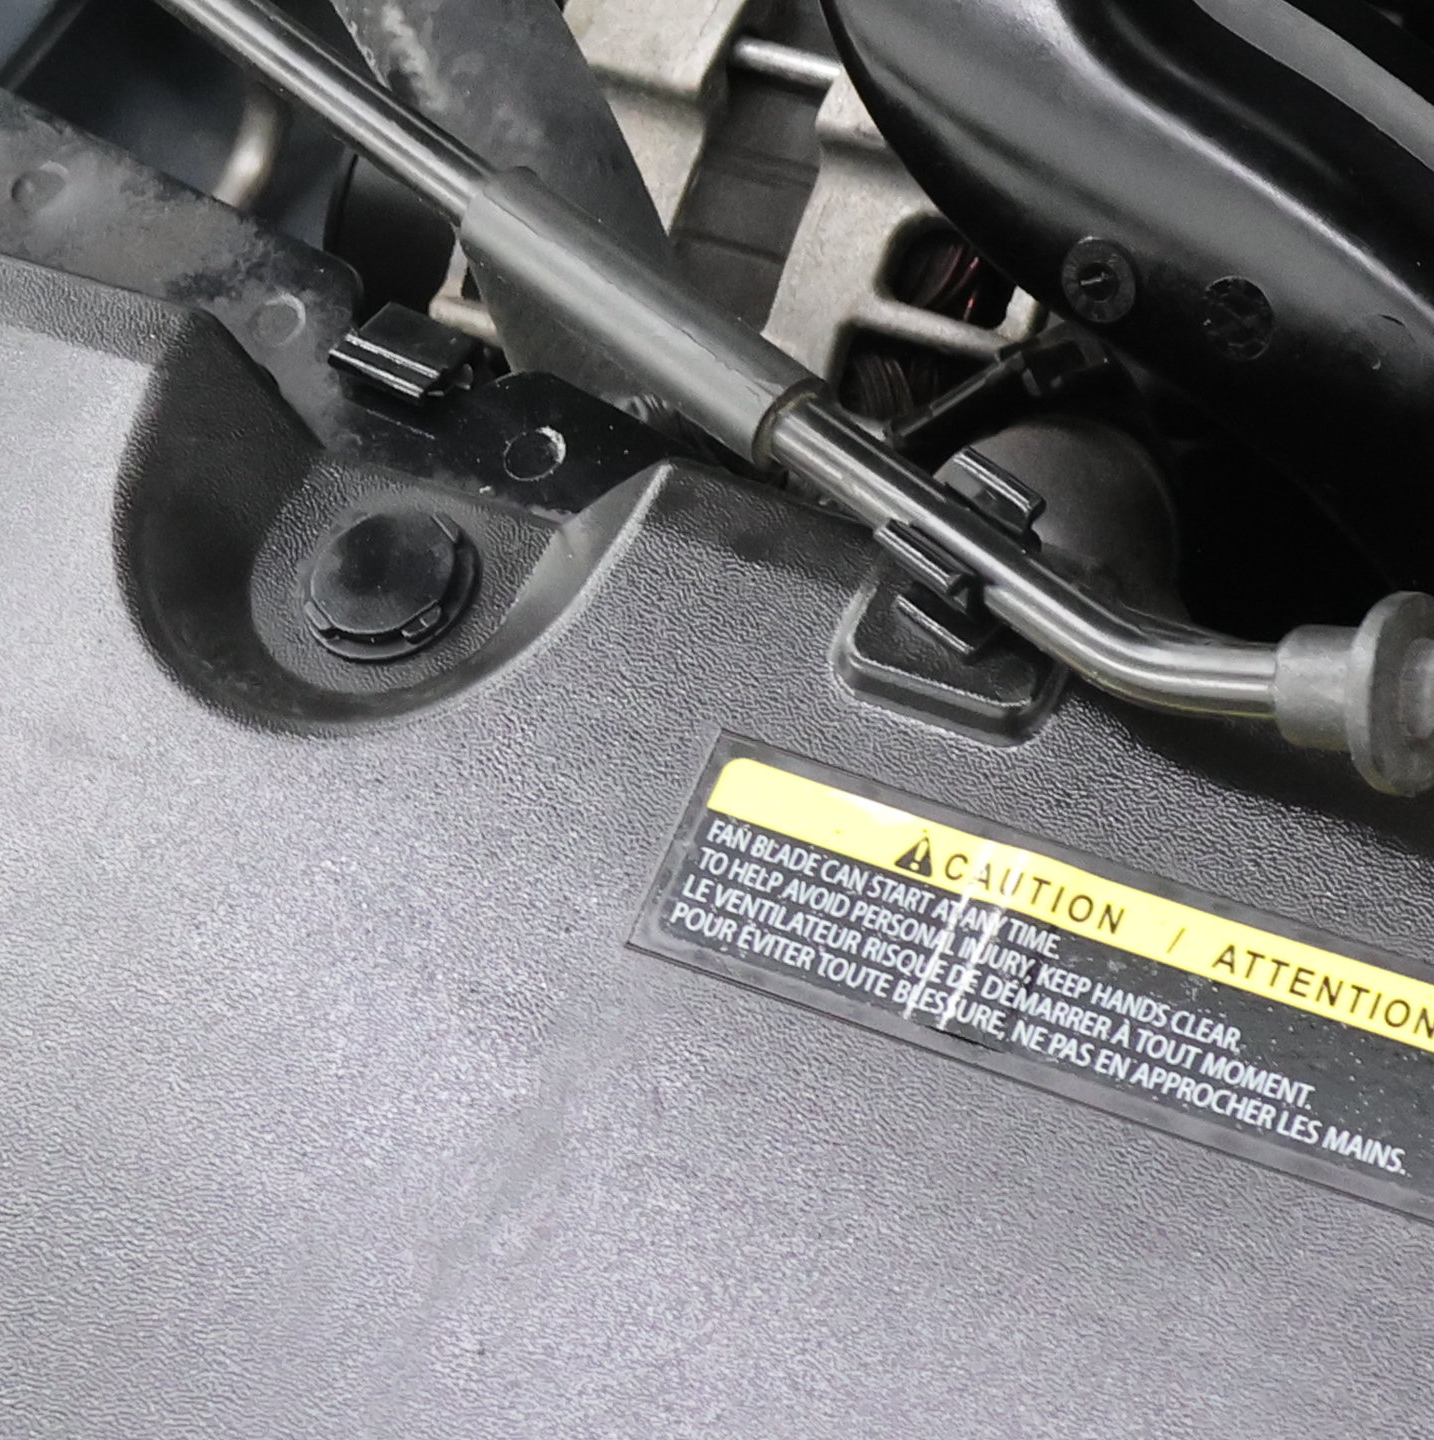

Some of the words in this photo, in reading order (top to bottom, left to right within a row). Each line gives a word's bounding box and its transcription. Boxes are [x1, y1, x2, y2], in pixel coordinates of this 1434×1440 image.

[682, 874, 711, 904] LE
[714, 883, 862, 955] VENTILATEUR
[863, 936, 949, 984] RISQUE
[946, 965, 976, 994] DE
[981, 972, 1113, 1040] DÉMARRER
[1110, 1019, 1132, 1047] À
[1137, 1027, 1199, 1068] TOUT
[1198, 1051, 1316, 1111] MOMENT.
[700, 847, 729, 875] TO
[729, 858, 785, 894] HELP
[781, 879, 851, 919] AVOID
[852, 900, 957, 956] PERSONAL
[957, 934, 1036, 983] INJURY,
[1036, 964, 1092, 1000] KEEP
[1090, 984, 1170, 1029] HANDS
[1169, 1010, 1243, 1054] CLEAR.
[706, 819, 749, 854] FAN
[750, 835, 822, 876] BLADE
[821, 859, 870, 894] CAN
[869, 875, 937, 914] START
[931, 896, 962, 922] AT
[961, 903, 1004, 933] ANY
[1008, 916, 1061, 960] TIME.
[945, 853, 1125, 935] CAUTION
[671, 902, 739, 941] POUR
[737, 919, 817, 971] ÉVITER
[818, 952, 898, 1000] TOUTE
[891, 978, 1008, 1039] BLESSURE,
[1011, 1022, 1049, 1052] NE
[1047, 1032, 1096, 1068] PAS
[1094, 1049, 1132, 1080] EN
[1128, 1062, 1277, 1131] APPROCHER
[1276, 1107, 1324, 1145] LES
[1321, 1126, 1408, 1177] MAINS.
